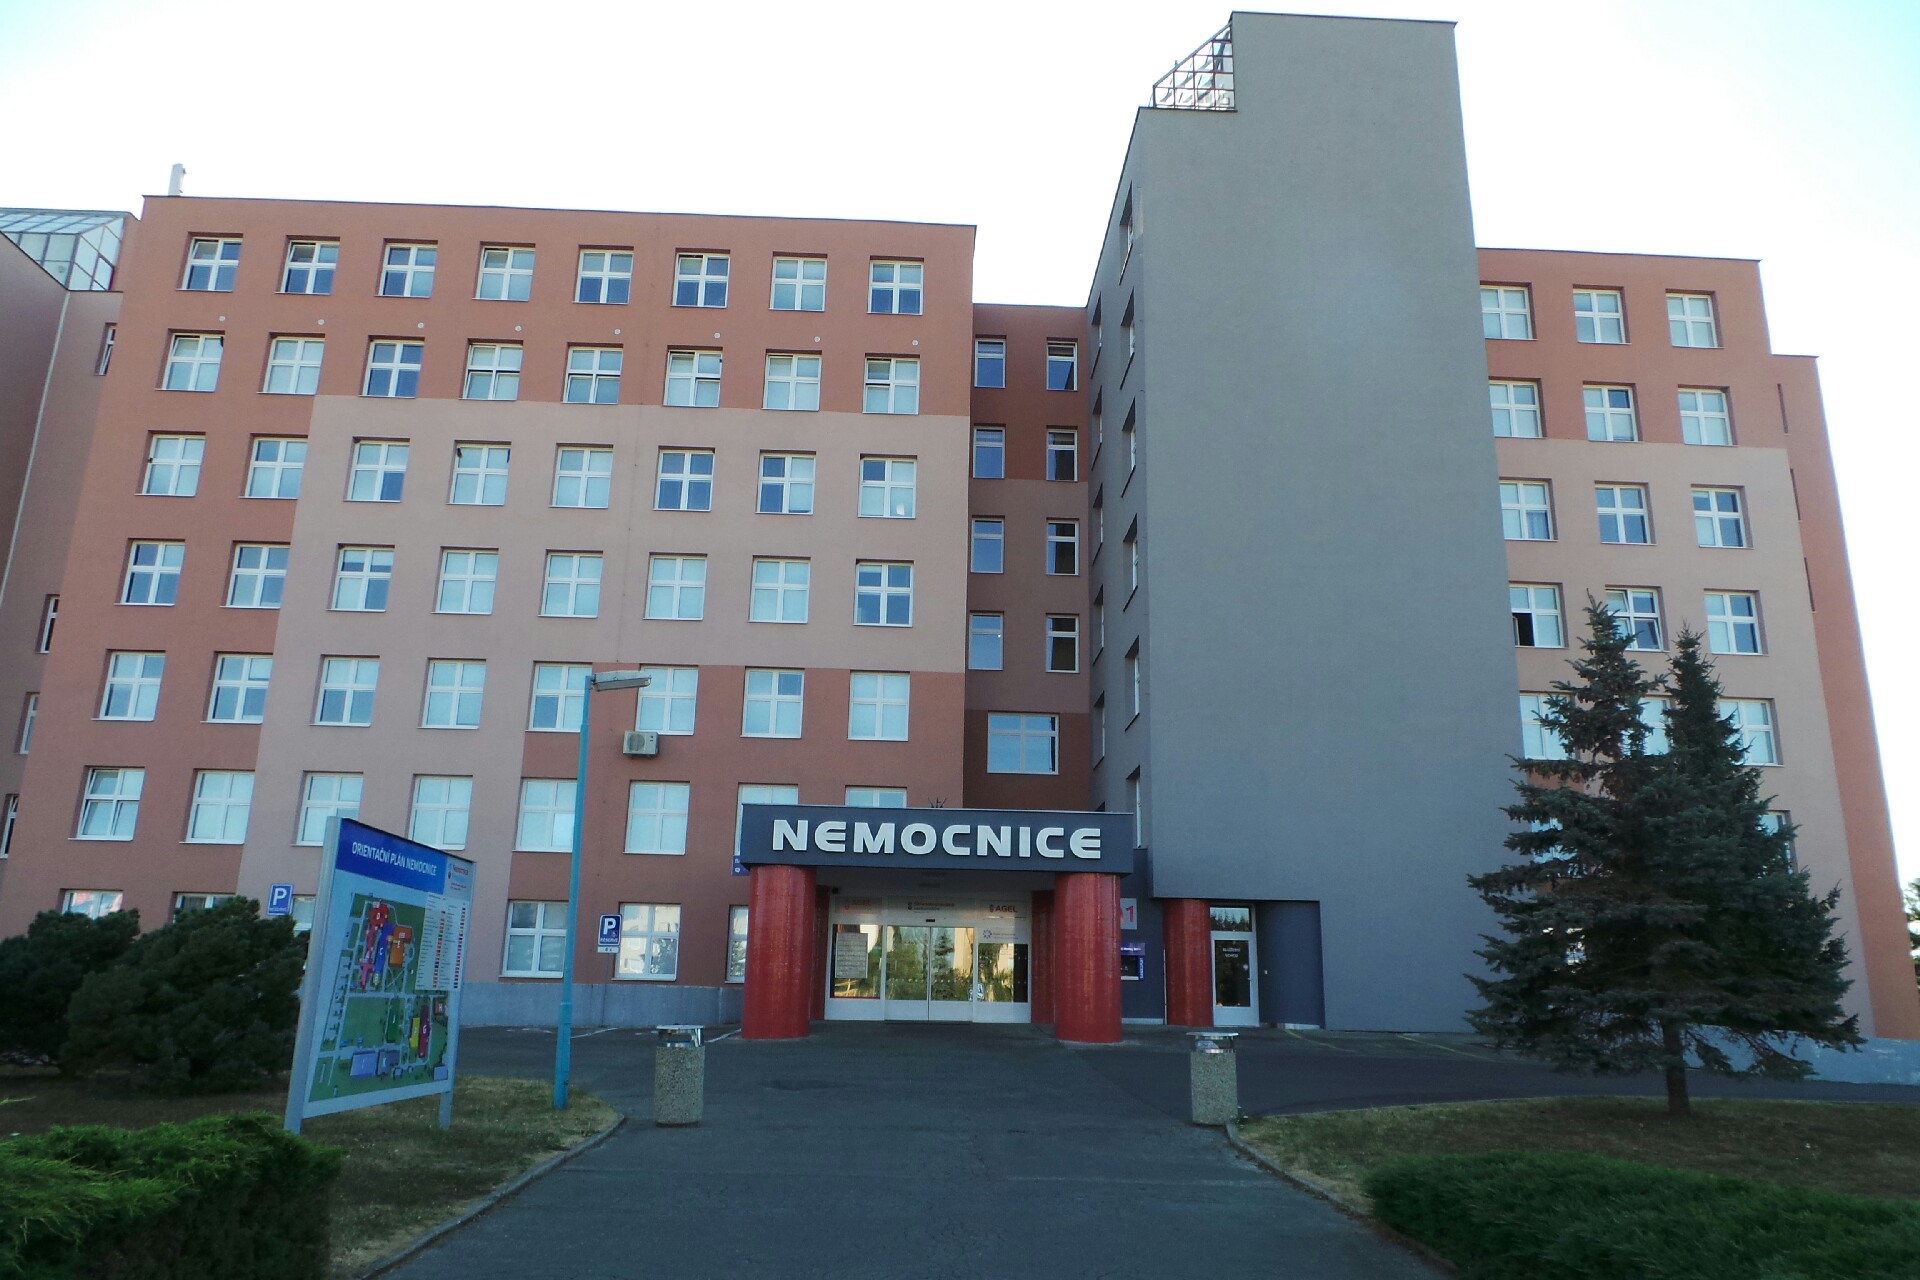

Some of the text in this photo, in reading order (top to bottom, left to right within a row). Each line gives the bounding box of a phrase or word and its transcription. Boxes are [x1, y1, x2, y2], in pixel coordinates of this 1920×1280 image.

[772, 818, 1101, 860] NEMOCNICE
[351, 841, 391, 864] ORIENTAČNÍ
[390, 851, 406, 868] PLÁN
[406, 857, 438, 876] NEMOCNICE
[273, 887, 287, 906] P
[995, 904, 1017, 913] AGEL
[603, 917, 617, 935] P
